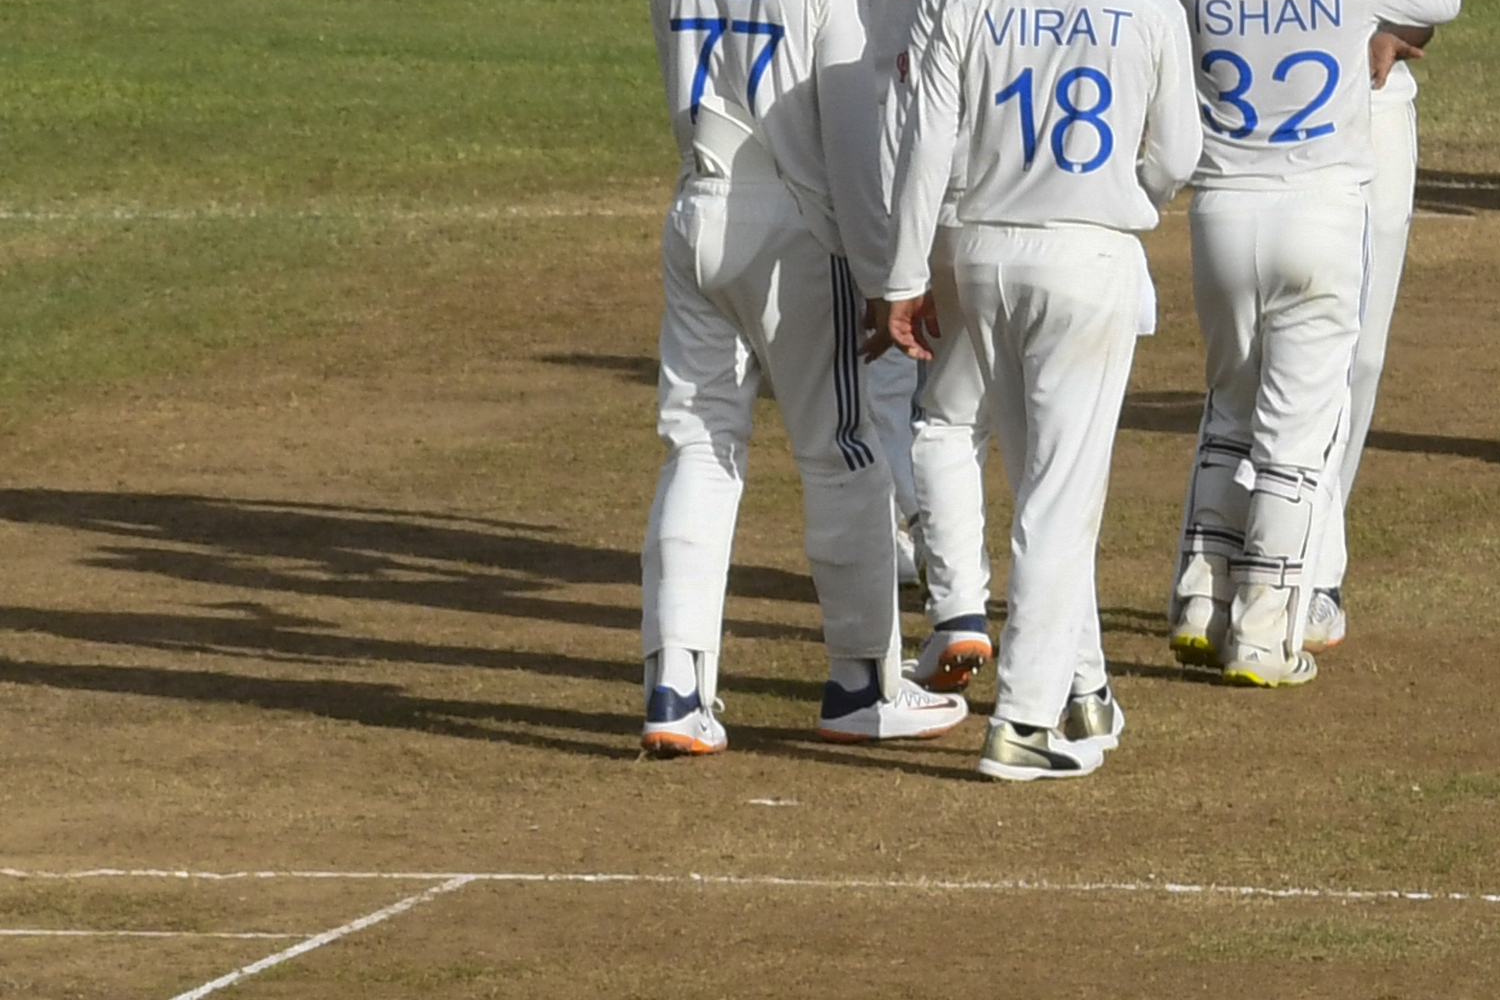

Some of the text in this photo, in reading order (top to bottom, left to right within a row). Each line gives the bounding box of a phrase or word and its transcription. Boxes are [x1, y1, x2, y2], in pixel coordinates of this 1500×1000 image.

[669, 17, 785, 125] 77
[984, 7, 1133, 47] VIRAT
[994, 66, 1115, 175] 18
[1200, 49, 1341, 143] 32
